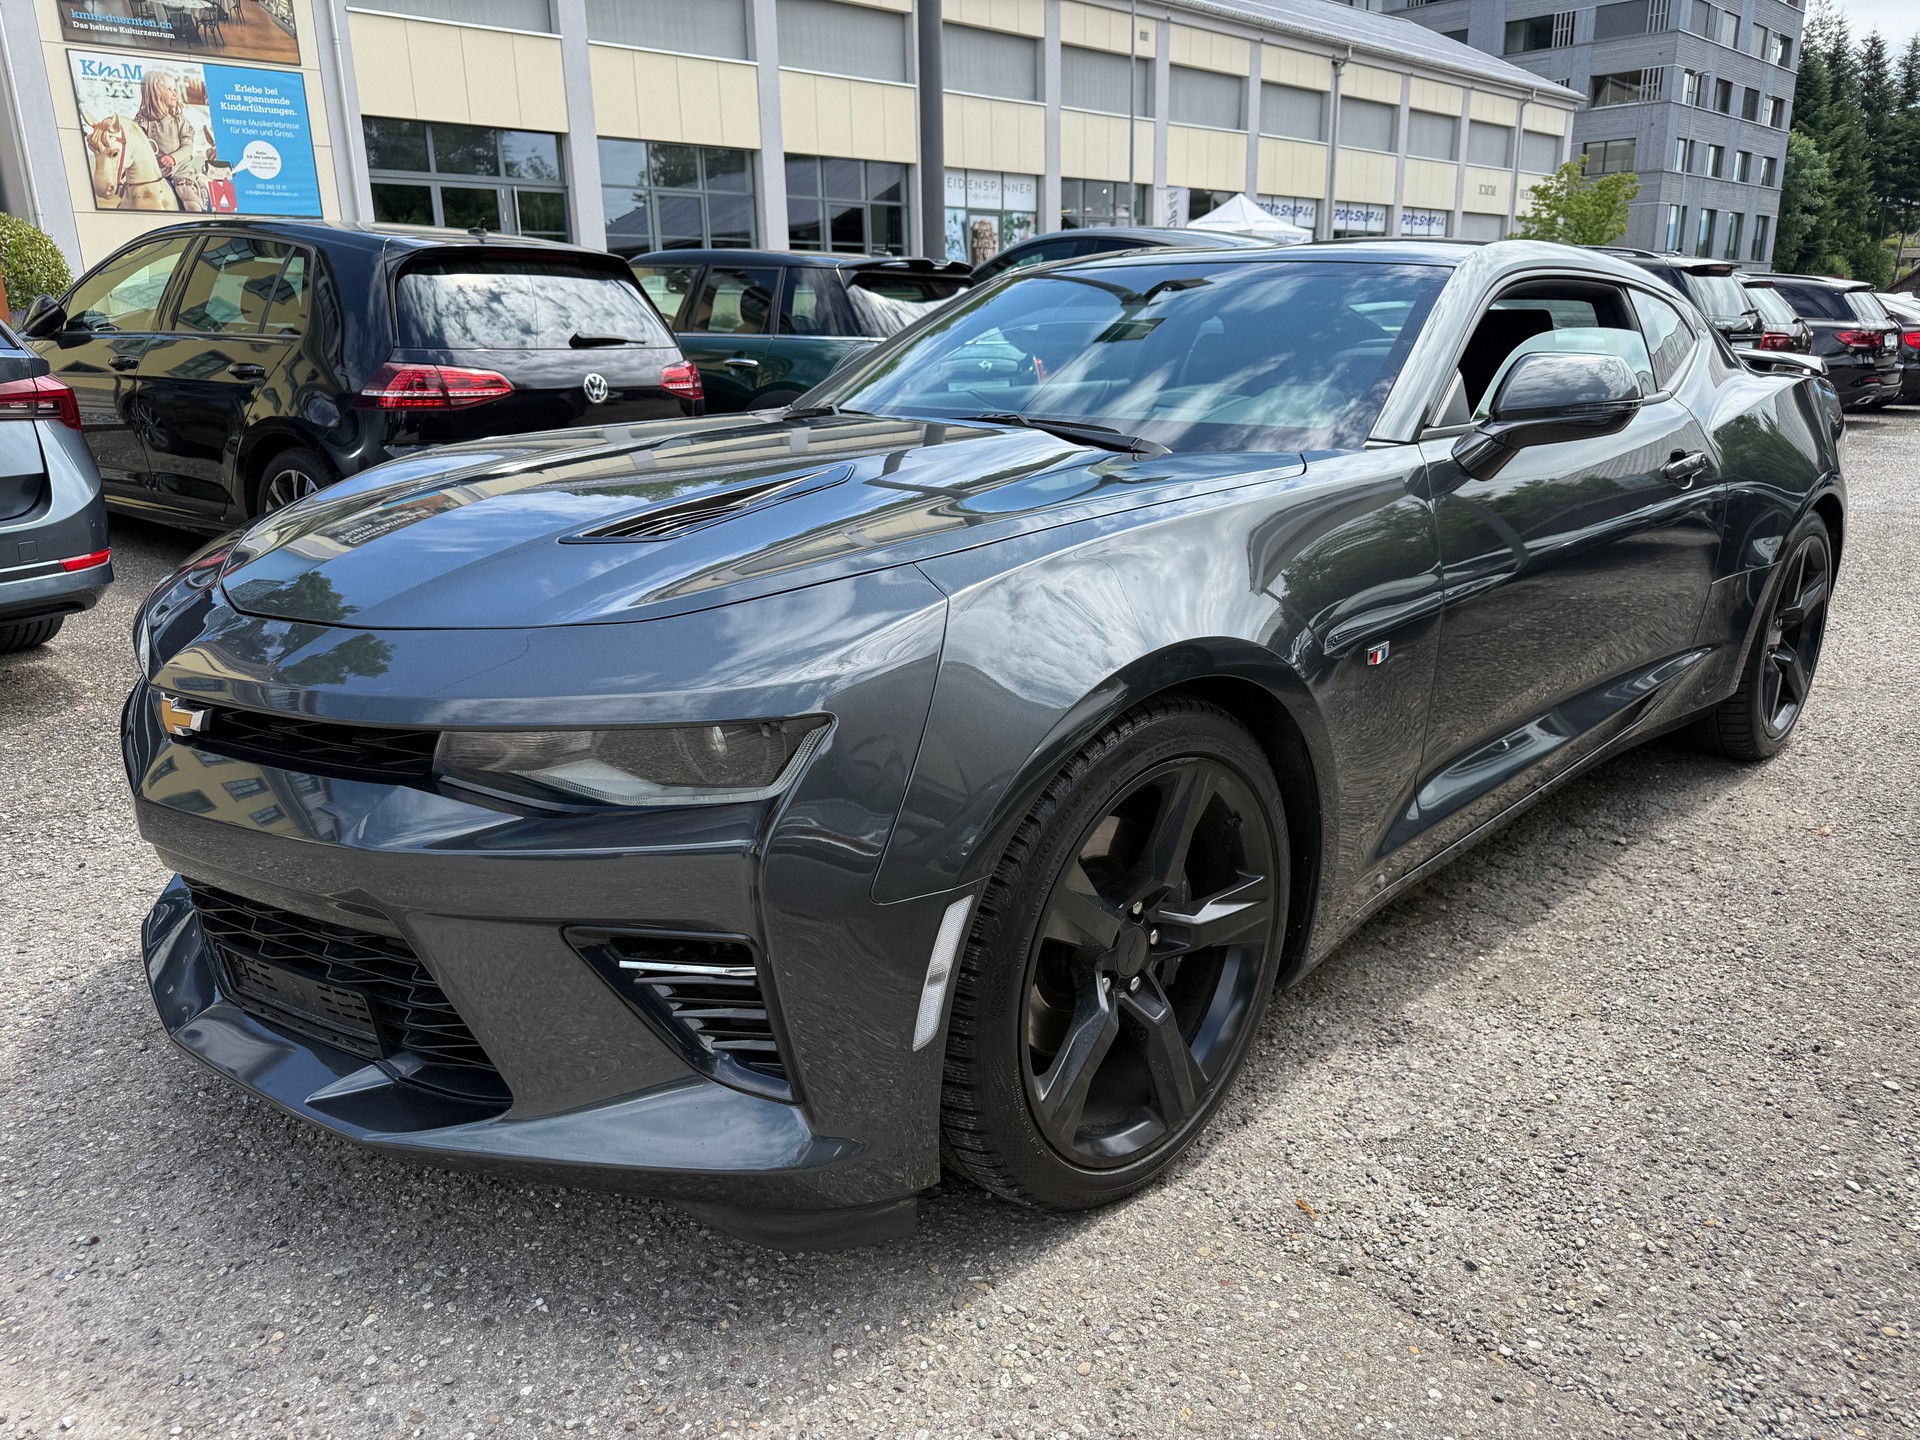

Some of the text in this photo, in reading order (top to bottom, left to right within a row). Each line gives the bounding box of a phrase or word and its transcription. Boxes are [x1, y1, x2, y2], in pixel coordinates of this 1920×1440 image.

[71, 8, 173, 30] kmm-duernten.ch
[73, 21, 175, 39] Das heitere Kulturzentrum
[234, 83, 278, 96] Erlebe bei
[224, 93, 290, 106] uns spannende
[220, 101, 298, 117] Kinderführungen.
[222, 117, 300, 130] Heitere Musikerlebnisse
[230, 126, 296, 138] für Klein und Gross.
[947, 177, 1033, 194] EIDENSPINNER
[584, 373, 608, 403] VW
